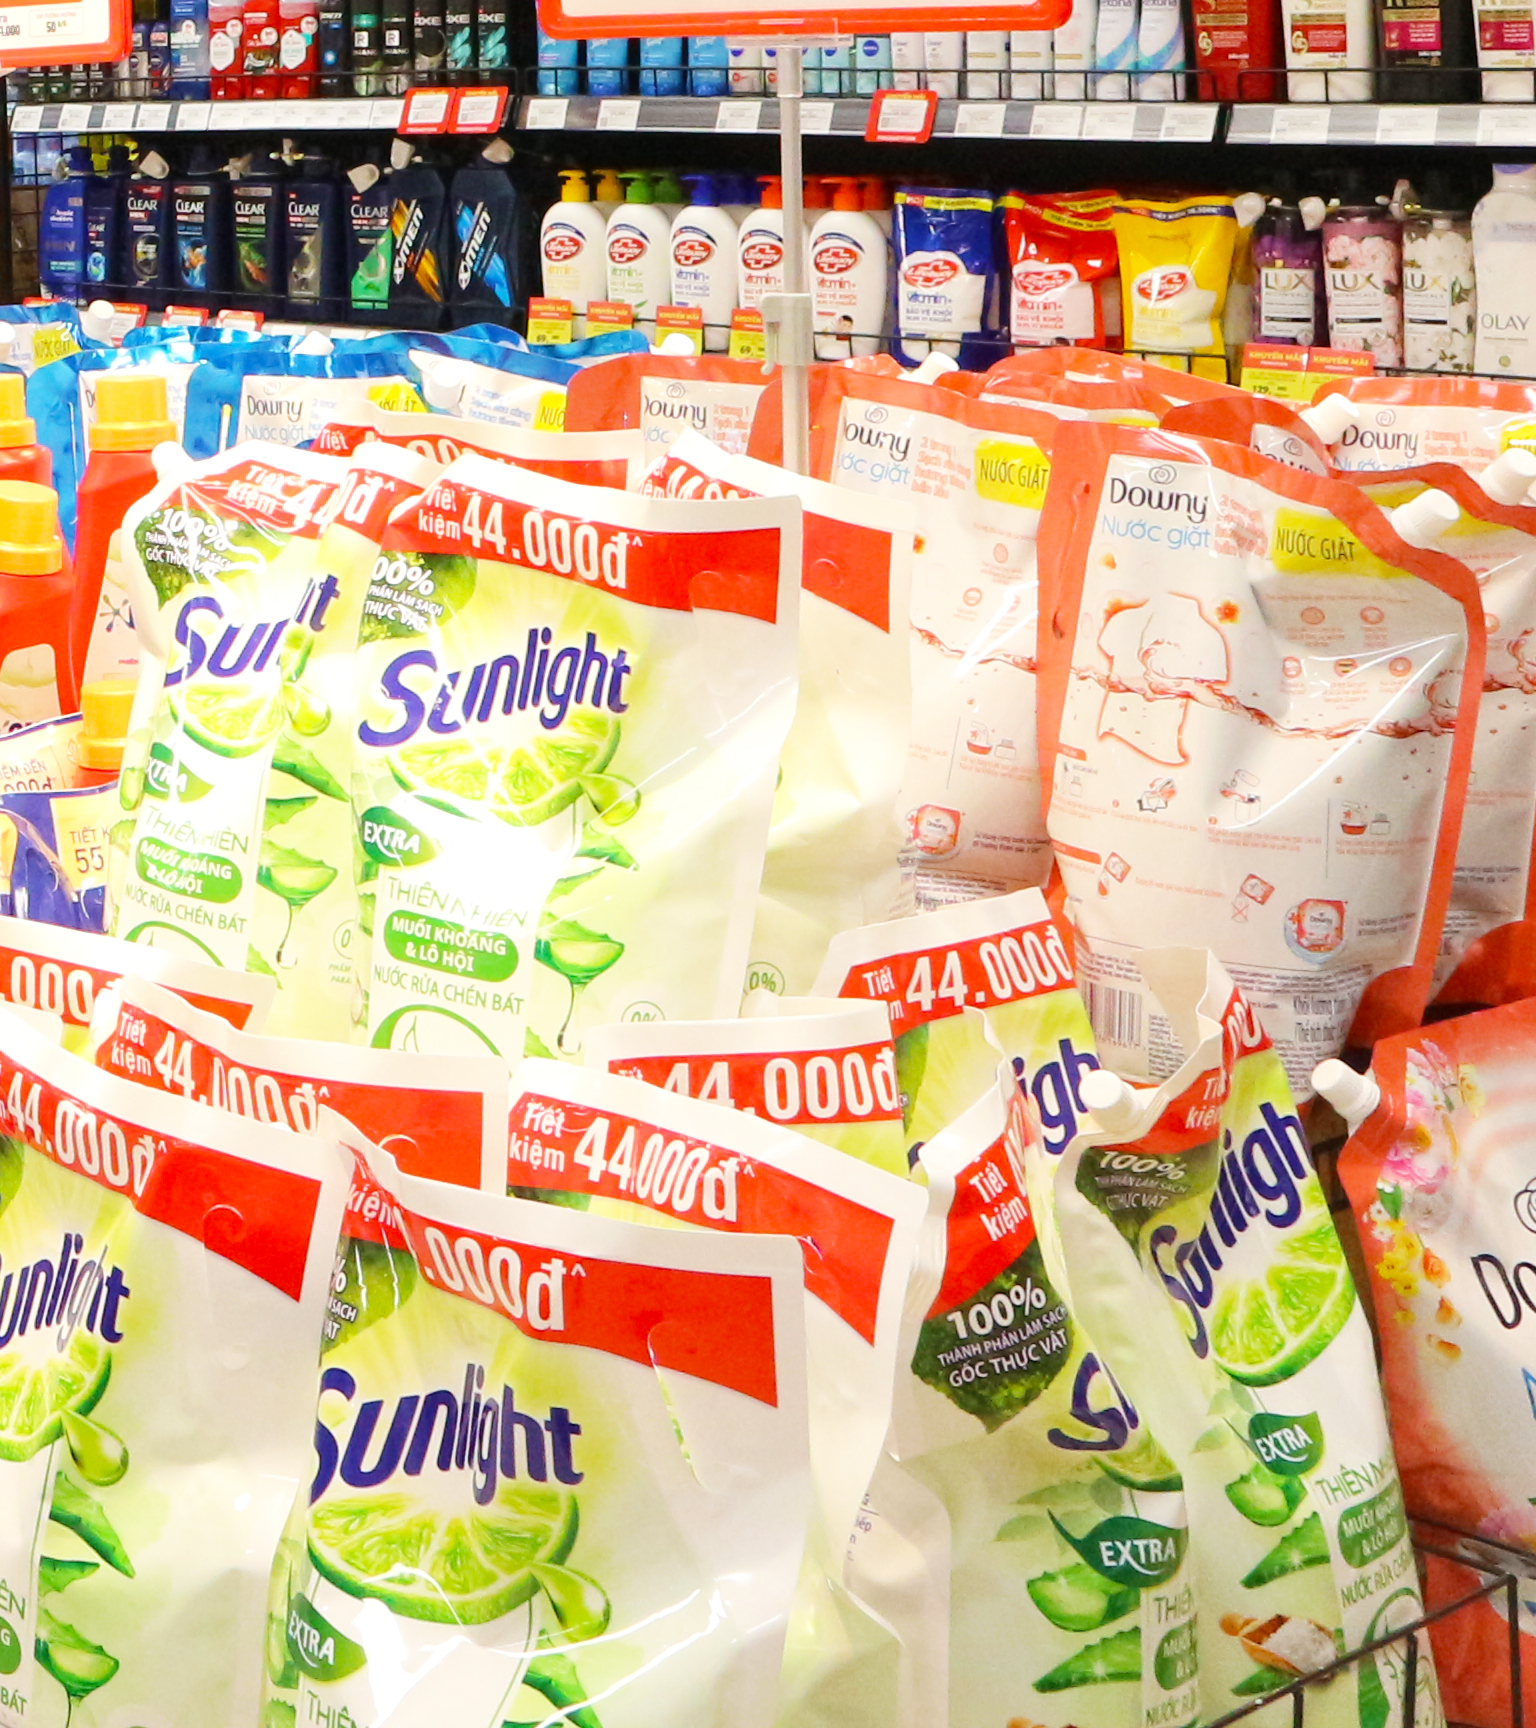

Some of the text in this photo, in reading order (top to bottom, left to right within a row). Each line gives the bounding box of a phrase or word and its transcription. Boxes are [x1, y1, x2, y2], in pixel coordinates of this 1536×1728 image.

[176, 200, 204, 213] CLEAR
[351, 204, 389, 218] CLEAR
[1264, 272, 1313, 291] LUX
[1481, 312, 1530, 332] OLAY
[1110, 478, 1208, 523] Downy
[1102, 515, 1160, 542] Nước
[1167, 523, 1210, 550] giặt
[1276, 526, 1316, 558] NƯỚC
[1321, 538, 1355, 564] GIẶT
[359, 627, 633, 748] Sunlight
[947, 1277, 1047, 1341] 100%
[949, 1328, 1068, 1387] GỐC THỰC VẬT
[309, 1361, 584, 1507] Sunlight
[1100, 1536, 1177, 1568] EXTRA
